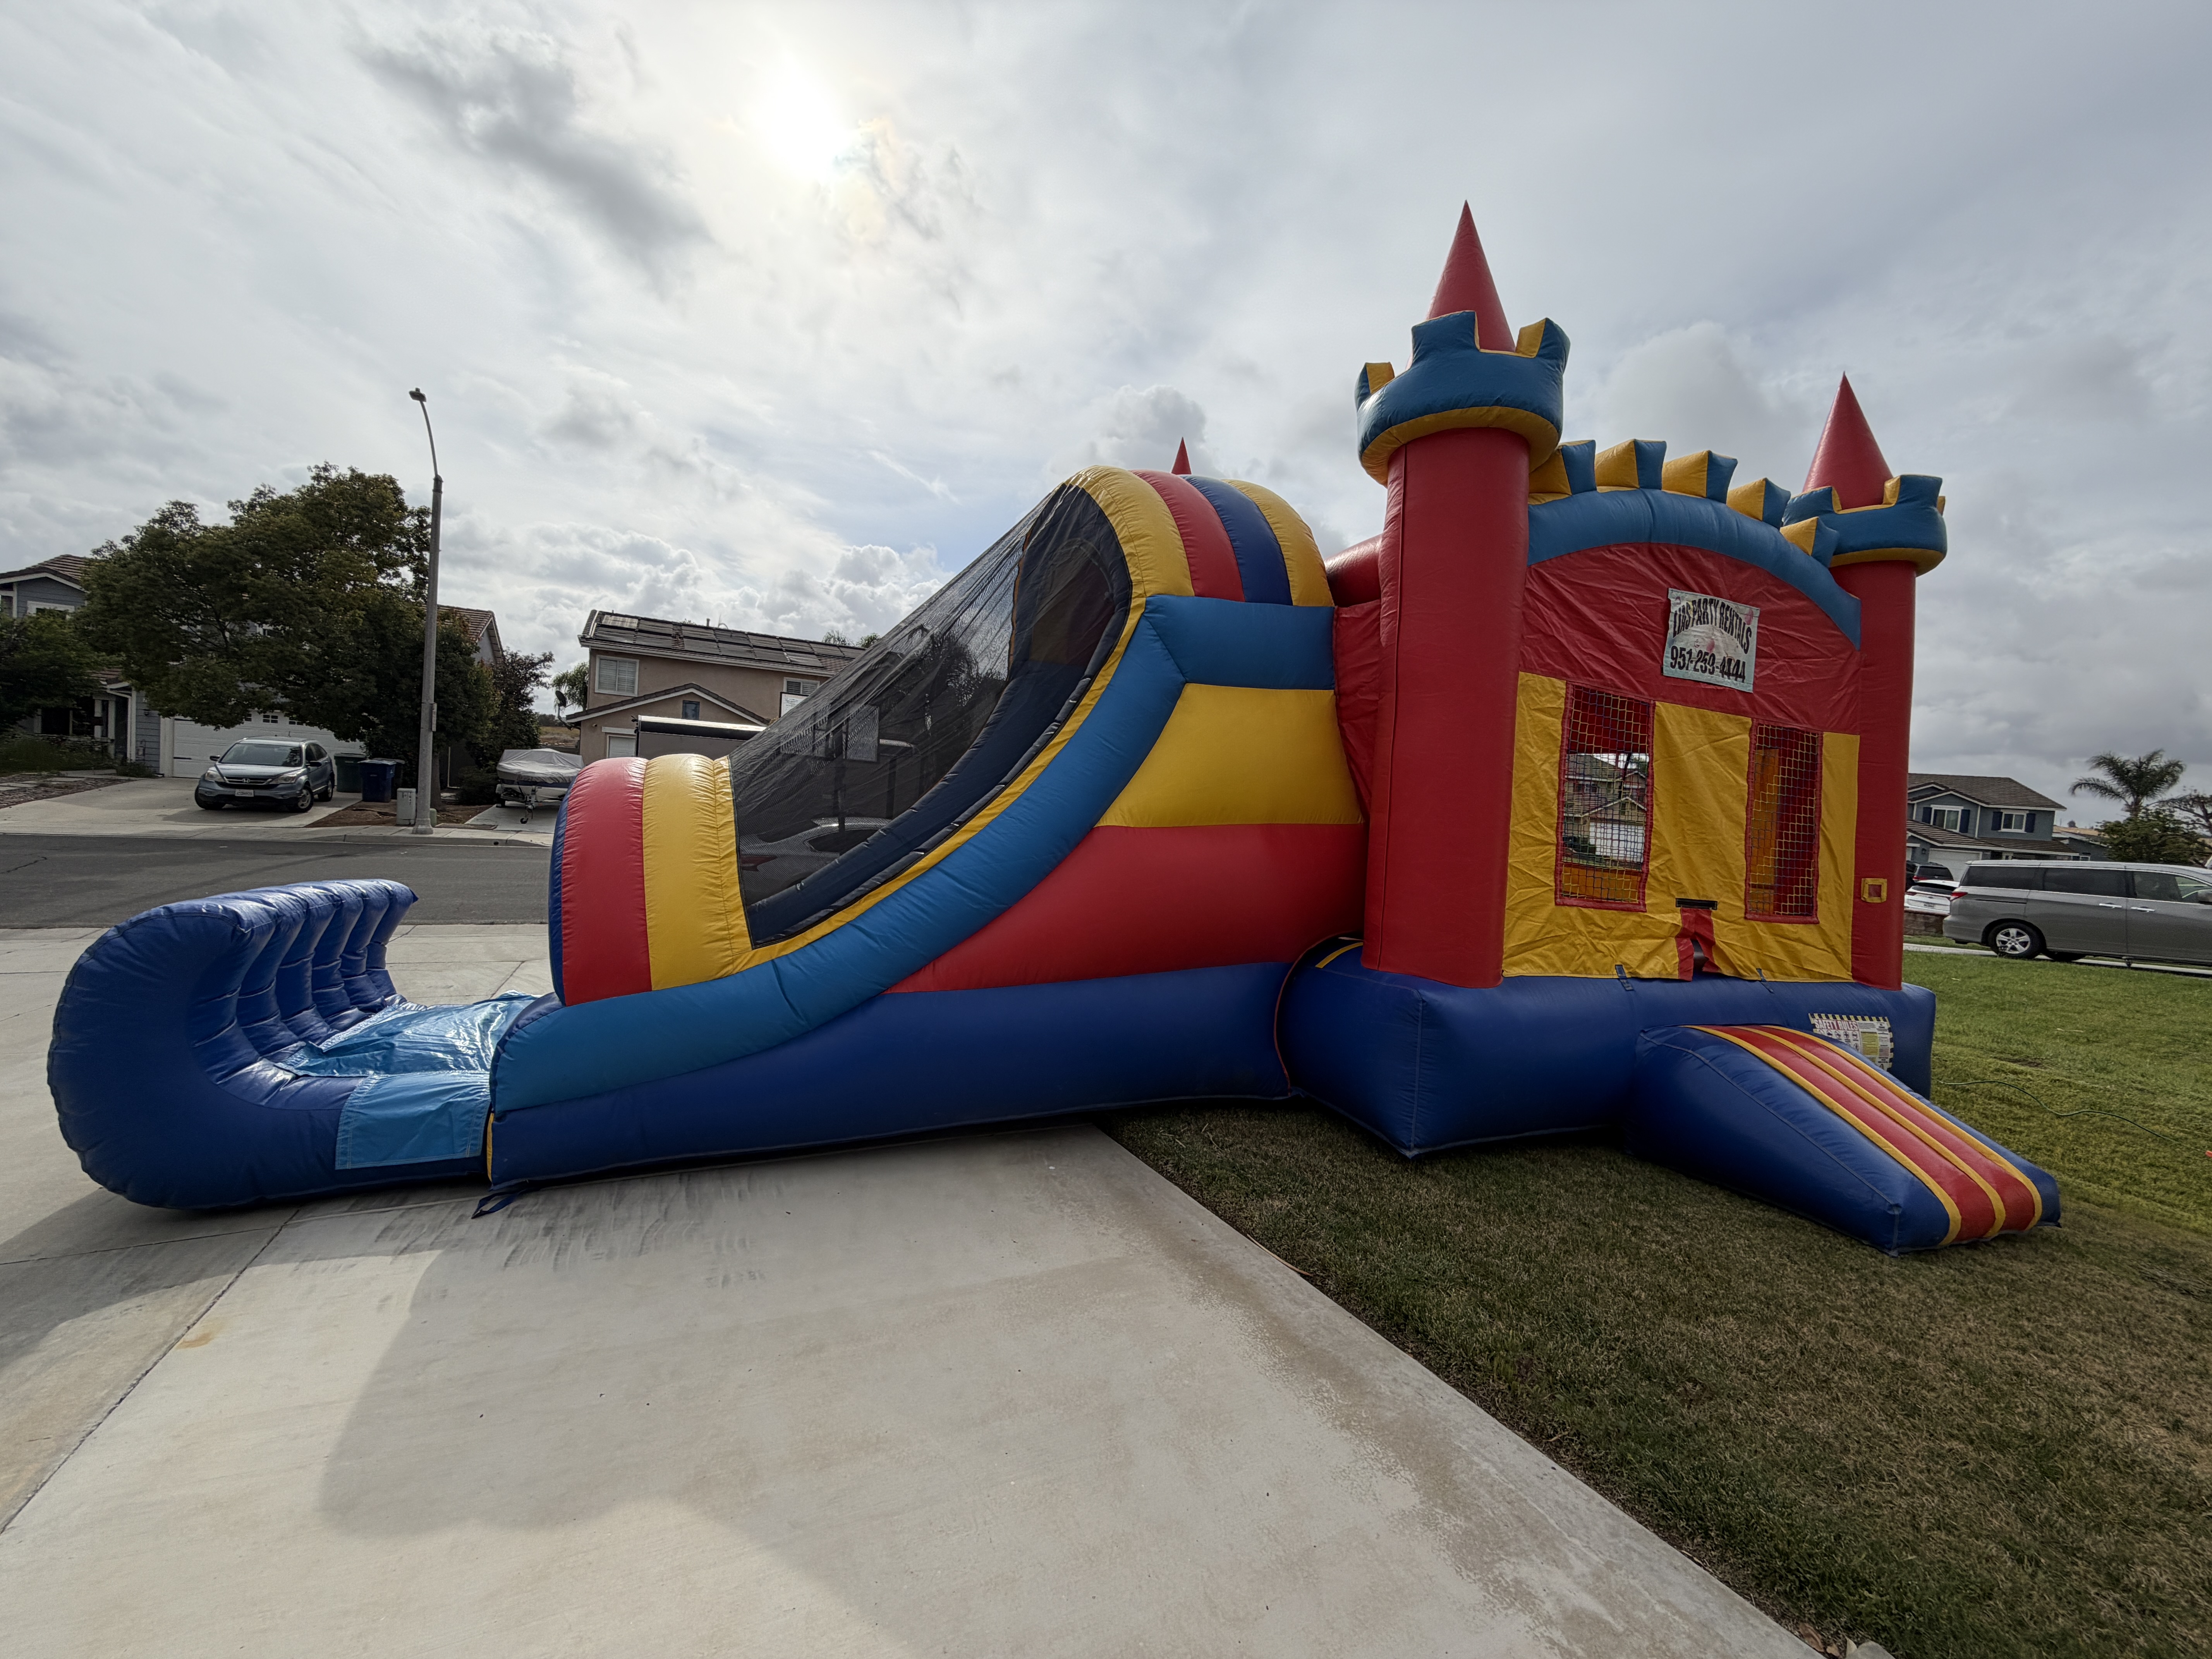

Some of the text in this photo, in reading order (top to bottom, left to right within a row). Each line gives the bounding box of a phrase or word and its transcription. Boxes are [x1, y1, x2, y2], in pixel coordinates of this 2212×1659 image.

[1691, 598, 1719, 627] PARTY
[1719, 601, 1752, 654] RENTALS
[1670, 645, 1746, 683] 951-259-4444
[1814, 1019, 1838, 1030] SAFETY
[1838, 1020, 1858, 1031] RULES
